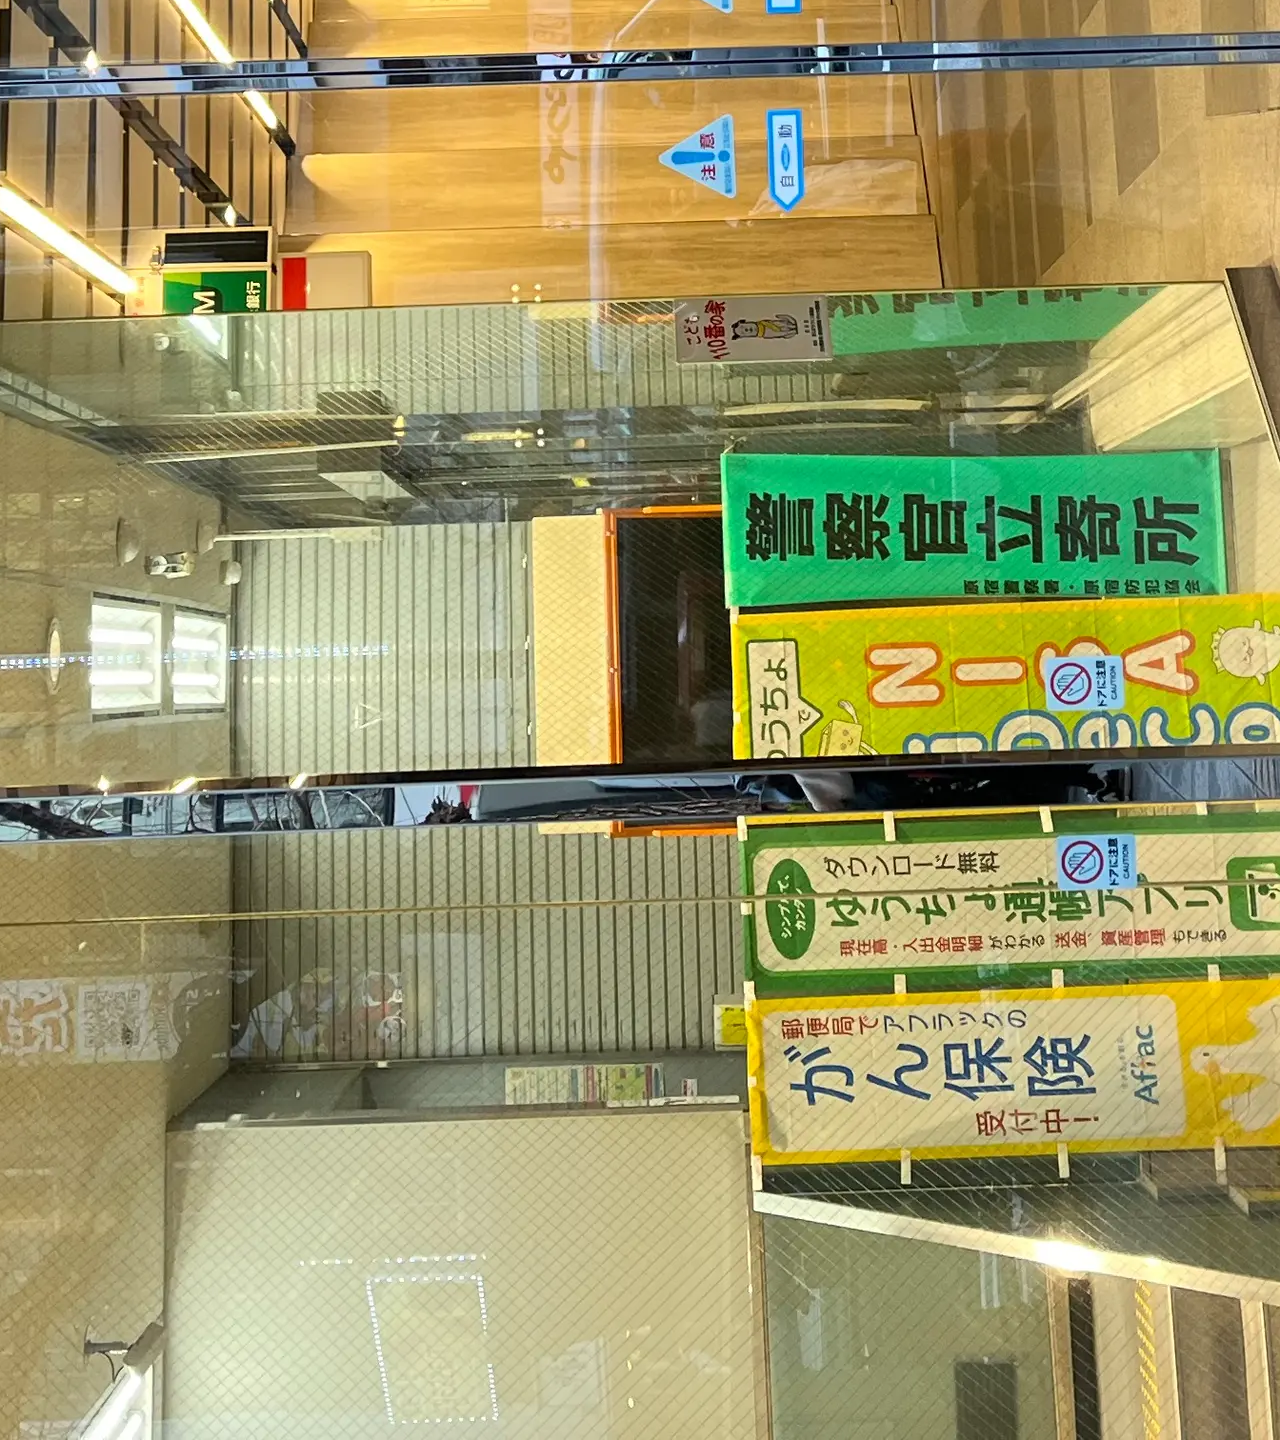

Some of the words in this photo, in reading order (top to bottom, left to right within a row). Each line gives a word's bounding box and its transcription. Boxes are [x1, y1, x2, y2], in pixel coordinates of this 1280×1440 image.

[245, 281, 261, 312] 銀行
[683, 315, 701, 345] こども
[704, 300, 731, 360] 110番の家
[745, 491, 1201, 567] 警察官立寄所
[963, 580, 1202, 595] 原宿警察署・原宿防犯協会
[1095, 660, 1108, 707] ドアに注意
[1109, 665, 1118, 700] CAUTION
[797, 709, 811, 724] で
[824, 851, 1000, 879] ダウンロード無料
[1108, 837, 1120, 887] ドアに注意
[1121, 843, 1131, 879] CAUTION
[781, 1009, 1028, 1040] 郵便局でアフラックの
[783, 1034, 1098, 1106] がん保険
[1130, 1024, 1160, 1106] Aflac
